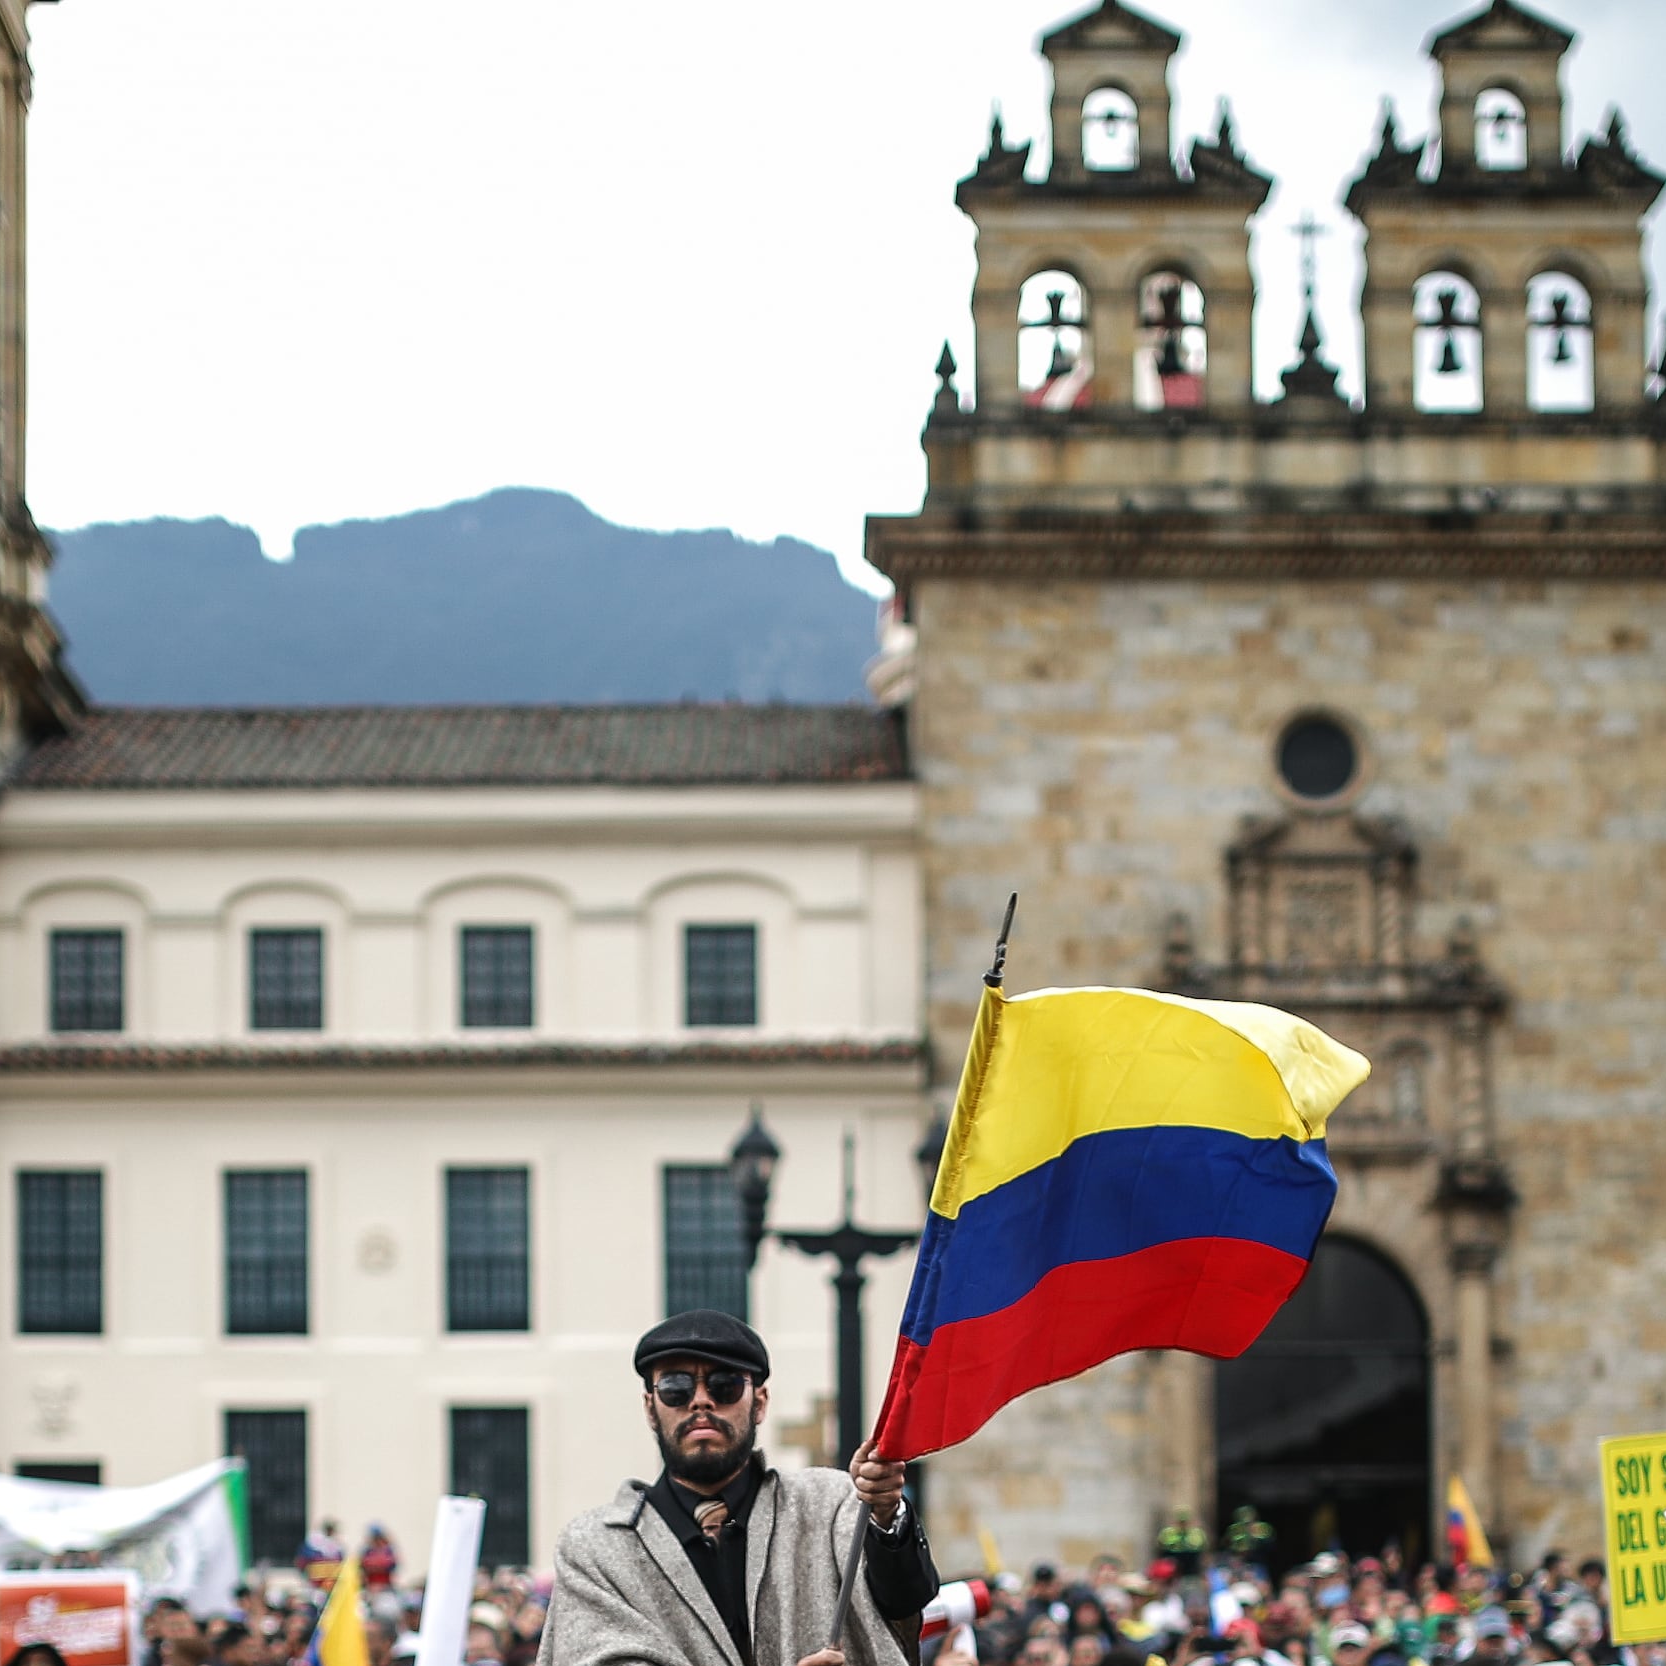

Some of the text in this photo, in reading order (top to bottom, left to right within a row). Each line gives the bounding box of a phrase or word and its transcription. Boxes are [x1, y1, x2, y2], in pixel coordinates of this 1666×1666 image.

[1615, 1456, 1653, 1497] SOY
[1616, 1511, 1649, 1552] DEL
[1620, 1561, 1647, 1606] LA
